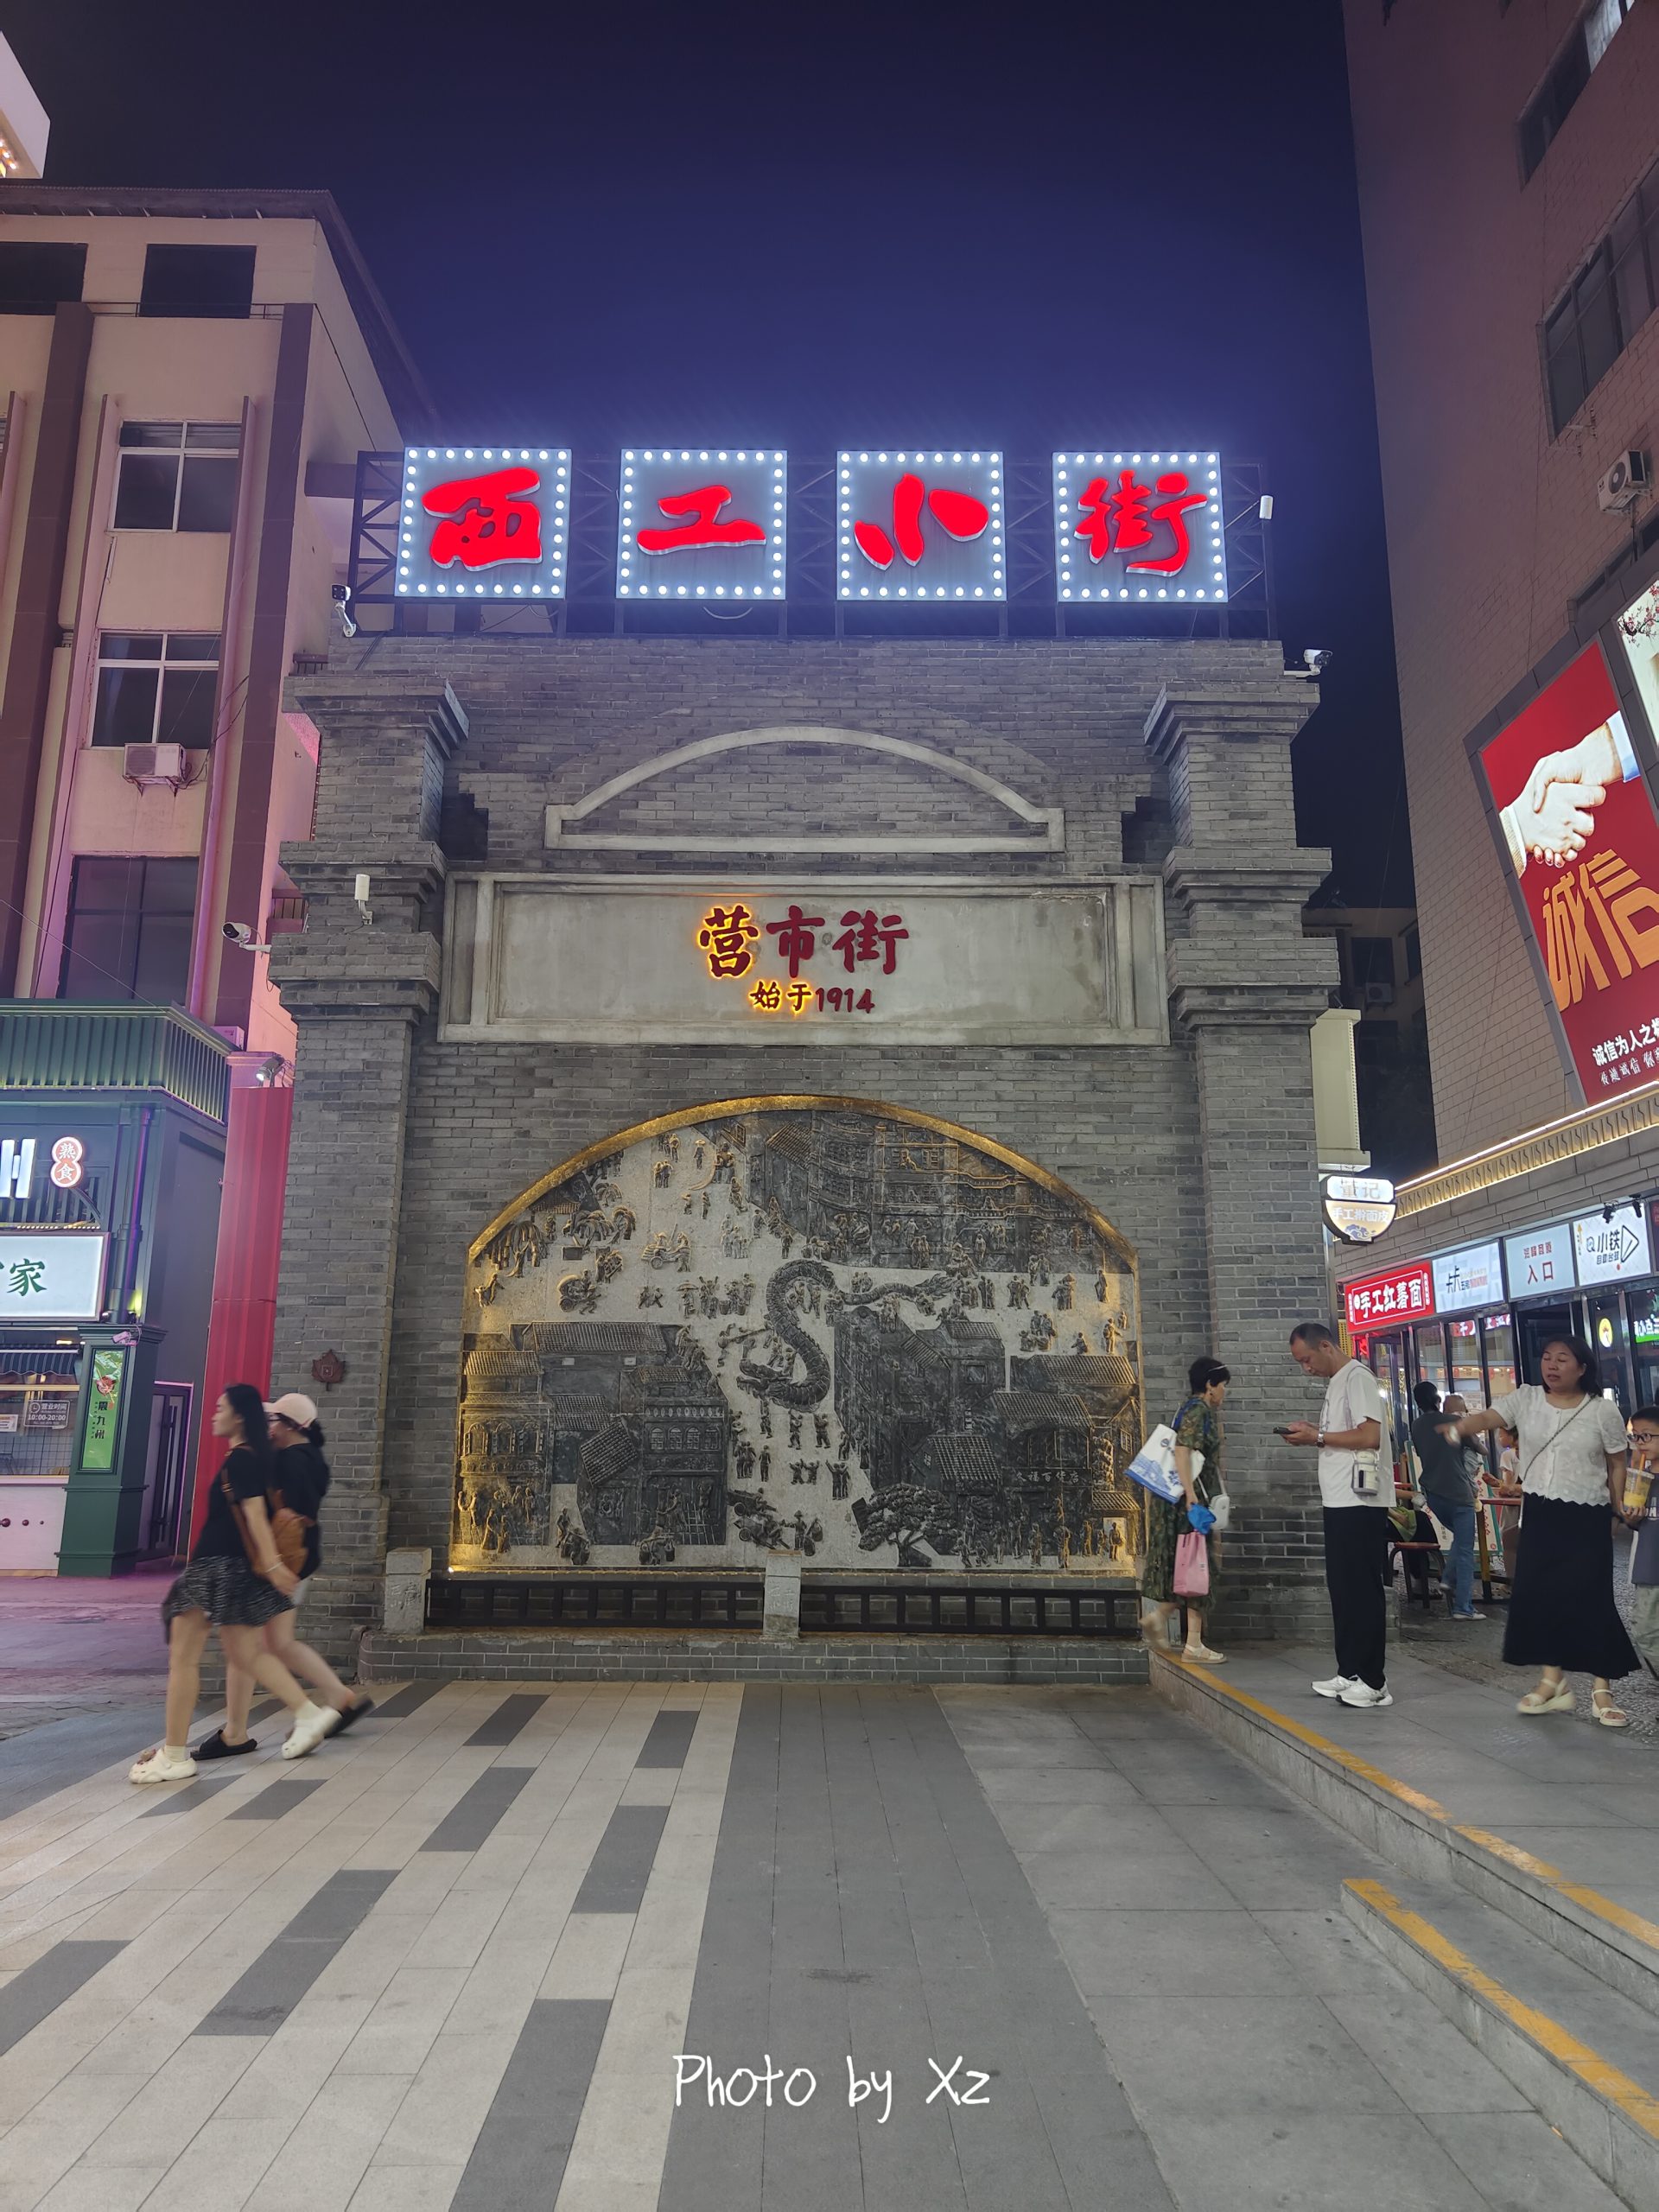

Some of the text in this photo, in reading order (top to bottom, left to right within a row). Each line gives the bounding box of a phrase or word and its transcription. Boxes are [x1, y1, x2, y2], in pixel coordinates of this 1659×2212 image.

[421, 466, 1208, 577] 西工小街
[698, 905, 909, 978] 营市街
[1542, 849, 1659, 1012] 诚信
[749, 981, 875, 1014] 始于1914
[57, 1142, 76, 1182] 熟食
[0, 1257, 48, 1297] 家
[1527, 1261, 1554, 1285] 入口
